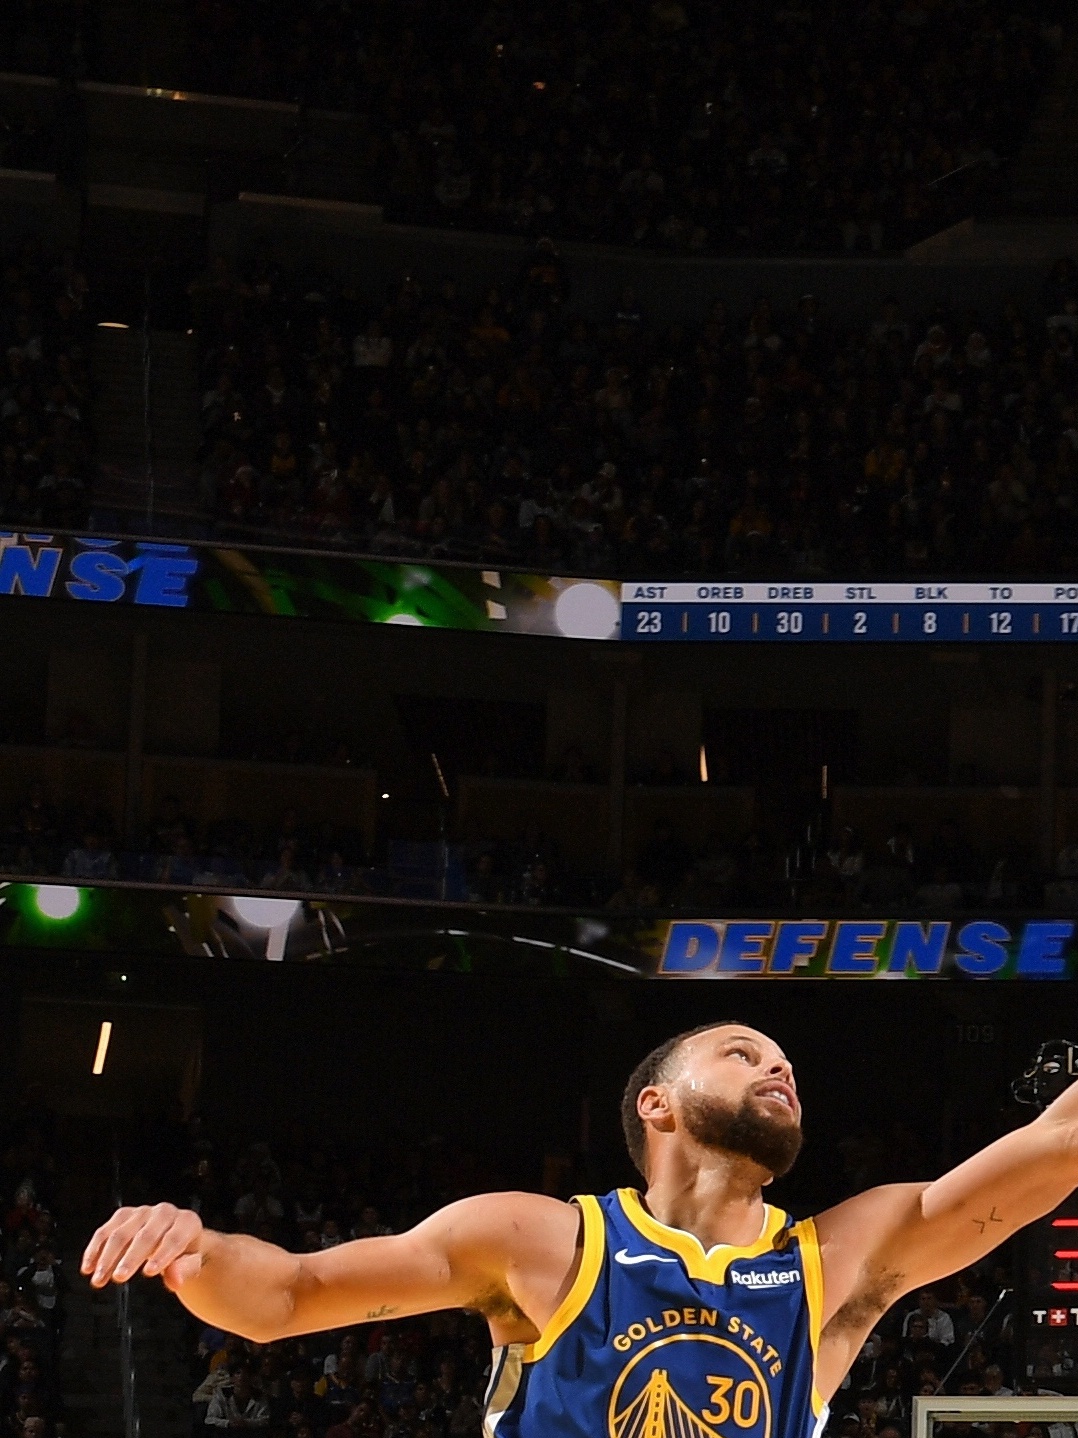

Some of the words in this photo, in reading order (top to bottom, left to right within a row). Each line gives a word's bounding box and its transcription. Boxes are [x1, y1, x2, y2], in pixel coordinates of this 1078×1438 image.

[634, 586, 668, 600] AST
[696, 586, 745, 600] OREB
[767, 586, 815, 600] DREB
[844, 586, 878, 600] STL
[914, 587, 949, 600] BLK
[989, 587, 1013, 600] TO
[635, 611, 663, 634] 23
[706, 611, 732, 634] 10
[775, 611, 804, 634] 30
[852, 611, 869, 634] 2
[922, 612, 938, 634] 8
[988, 612, 1013, 634] 12
[658, 921, 1076, 975] DEFENSE
[731, 1269, 800, 1288] Rakuten
[612, 1307, 718, 1353] GOLDEN
[727, 1315, 784, 1379] STATE
[701, 1374, 761, 1428] 30
